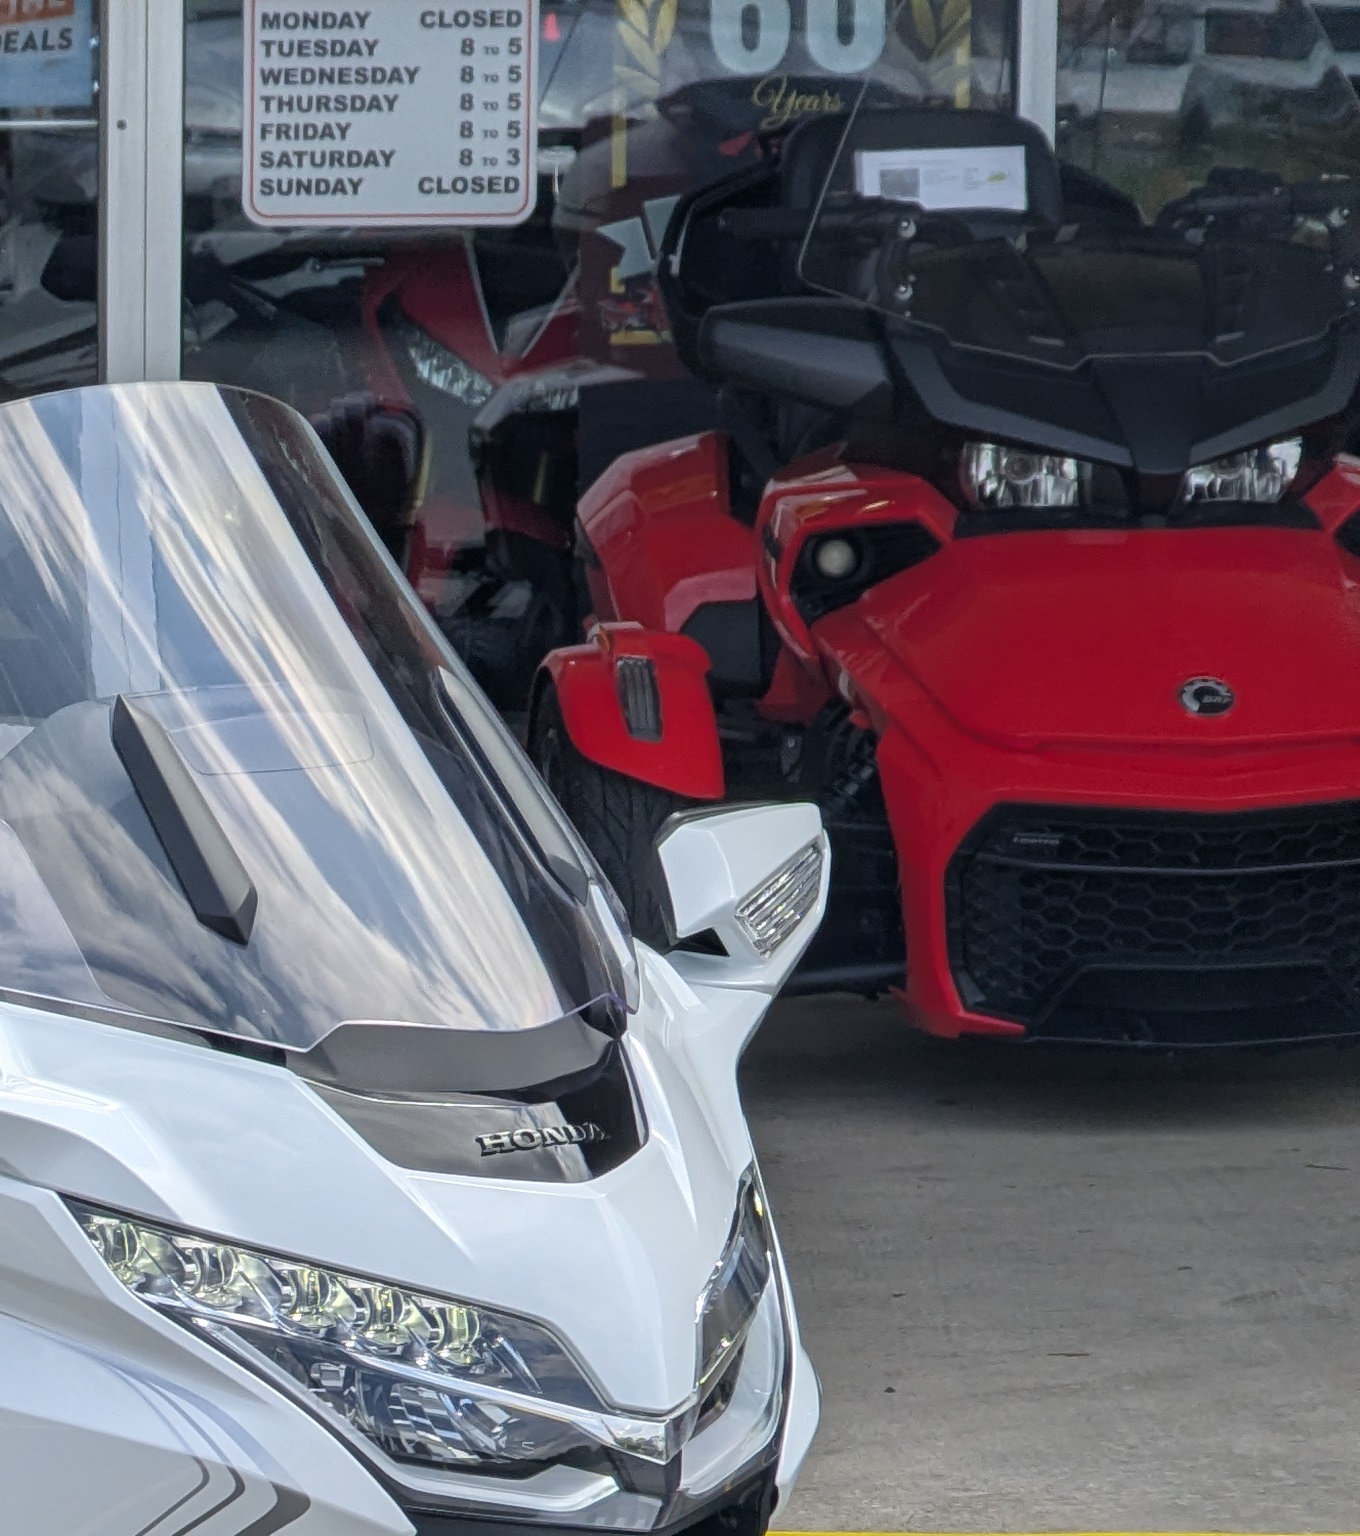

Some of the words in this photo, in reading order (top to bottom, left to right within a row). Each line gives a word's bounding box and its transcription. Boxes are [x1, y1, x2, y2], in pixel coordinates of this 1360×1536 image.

[260, 11, 371, 30] MONDAY
[420, 9, 522, 28] CLOSED
[260, 38, 379, 58] TUESDAY
[459, 37, 474, 56] 8
[507, 37, 522, 56] 5
[260, 66, 421, 85] WEDNESDAY
[459, 65, 474, 83] 8
[507, 65, 522, 83] 5
[260, 94, 399, 113] THURSDAY
[459, 93, 474, 111] 8
[507, 93, 522, 111] 5
[260, 122, 352, 141] FRIDAY
[459, 121, 474, 139] 8
[507, 121, 522, 139] 5
[260, 149, 396, 169] SATURDAY
[459, 148, 474, 167] 8
[507, 148, 522, 167] 3
[260, 177, 363, 196] SUNDAY
[418, 176, 521, 194] CLOSED
[475, 1121, 612, 1157] HONDA
